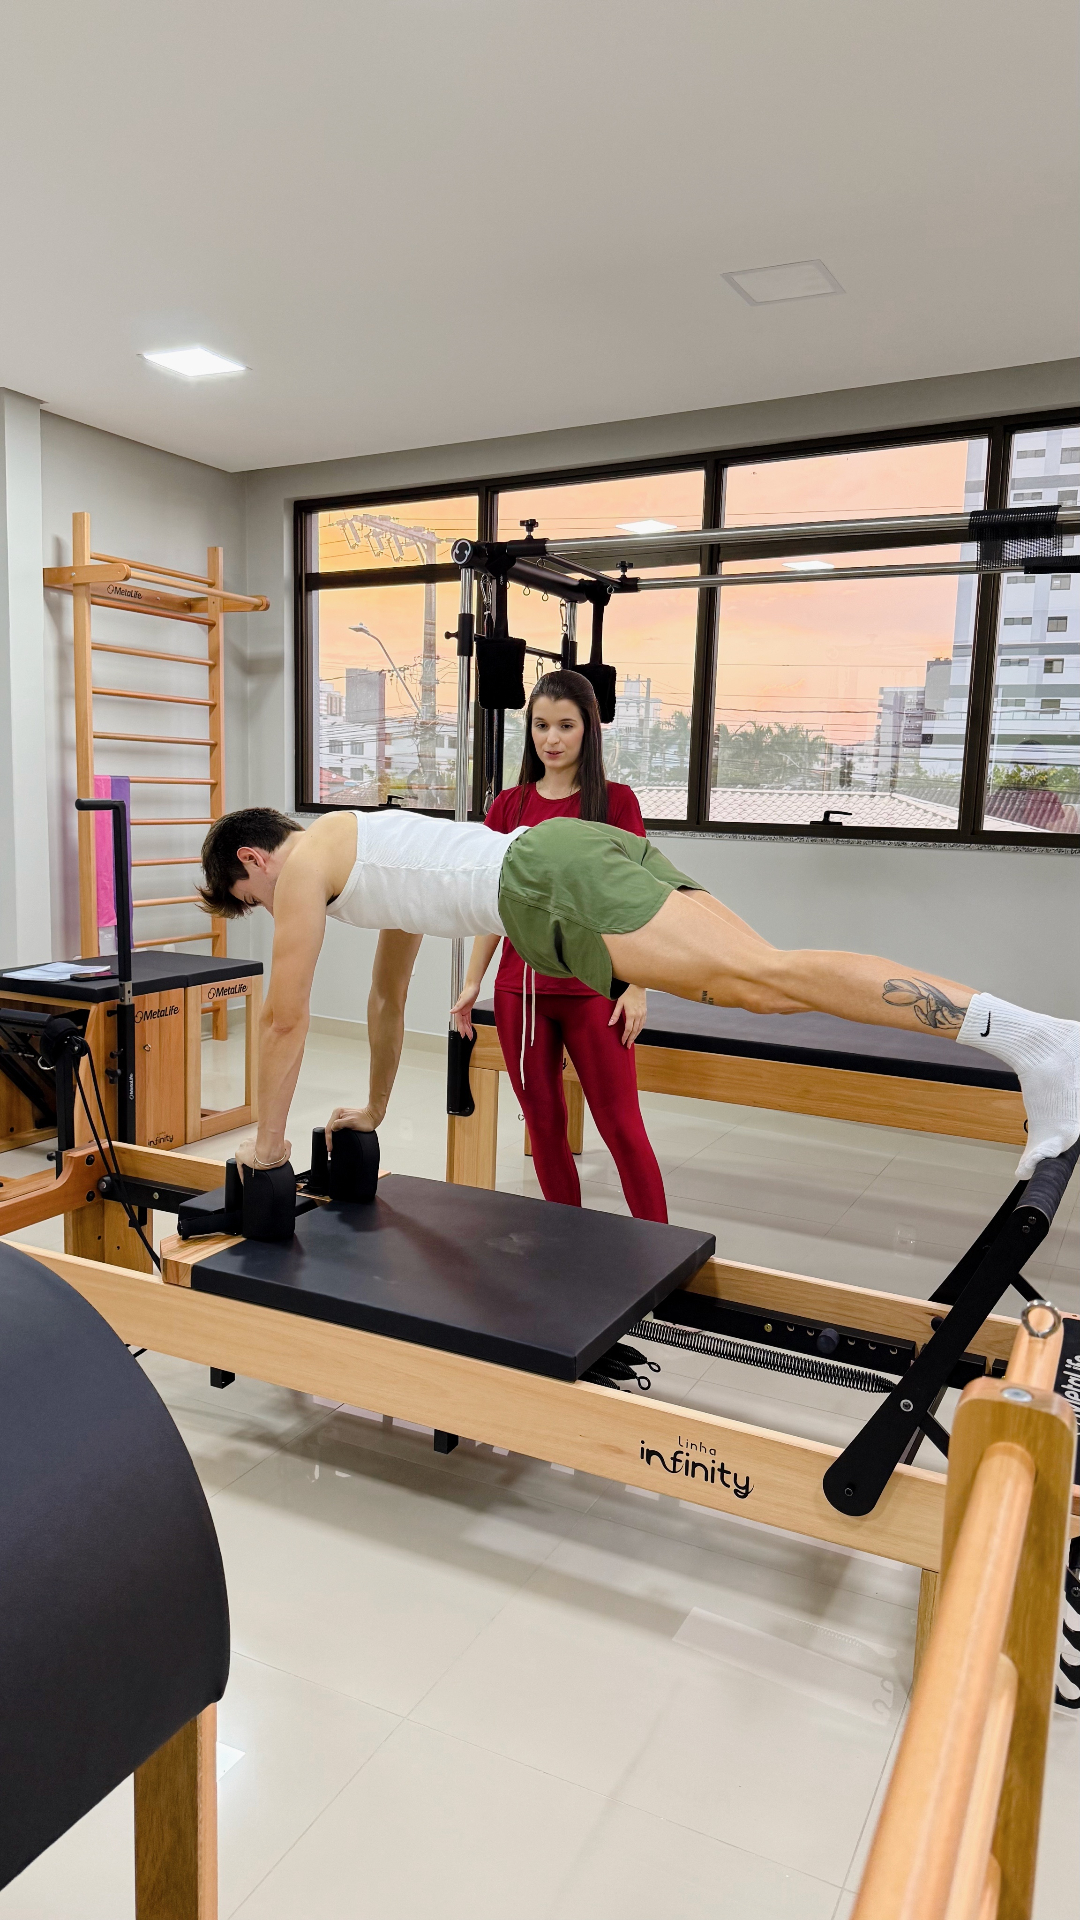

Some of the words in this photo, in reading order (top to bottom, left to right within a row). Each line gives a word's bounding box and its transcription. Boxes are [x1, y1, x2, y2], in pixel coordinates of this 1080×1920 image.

[113, 586, 143, 600] MetaLife
[215, 983, 248, 998] MetaLife
[143, 1005, 180, 1021] MetaLife
[640, 1440, 755, 1499] infinity
